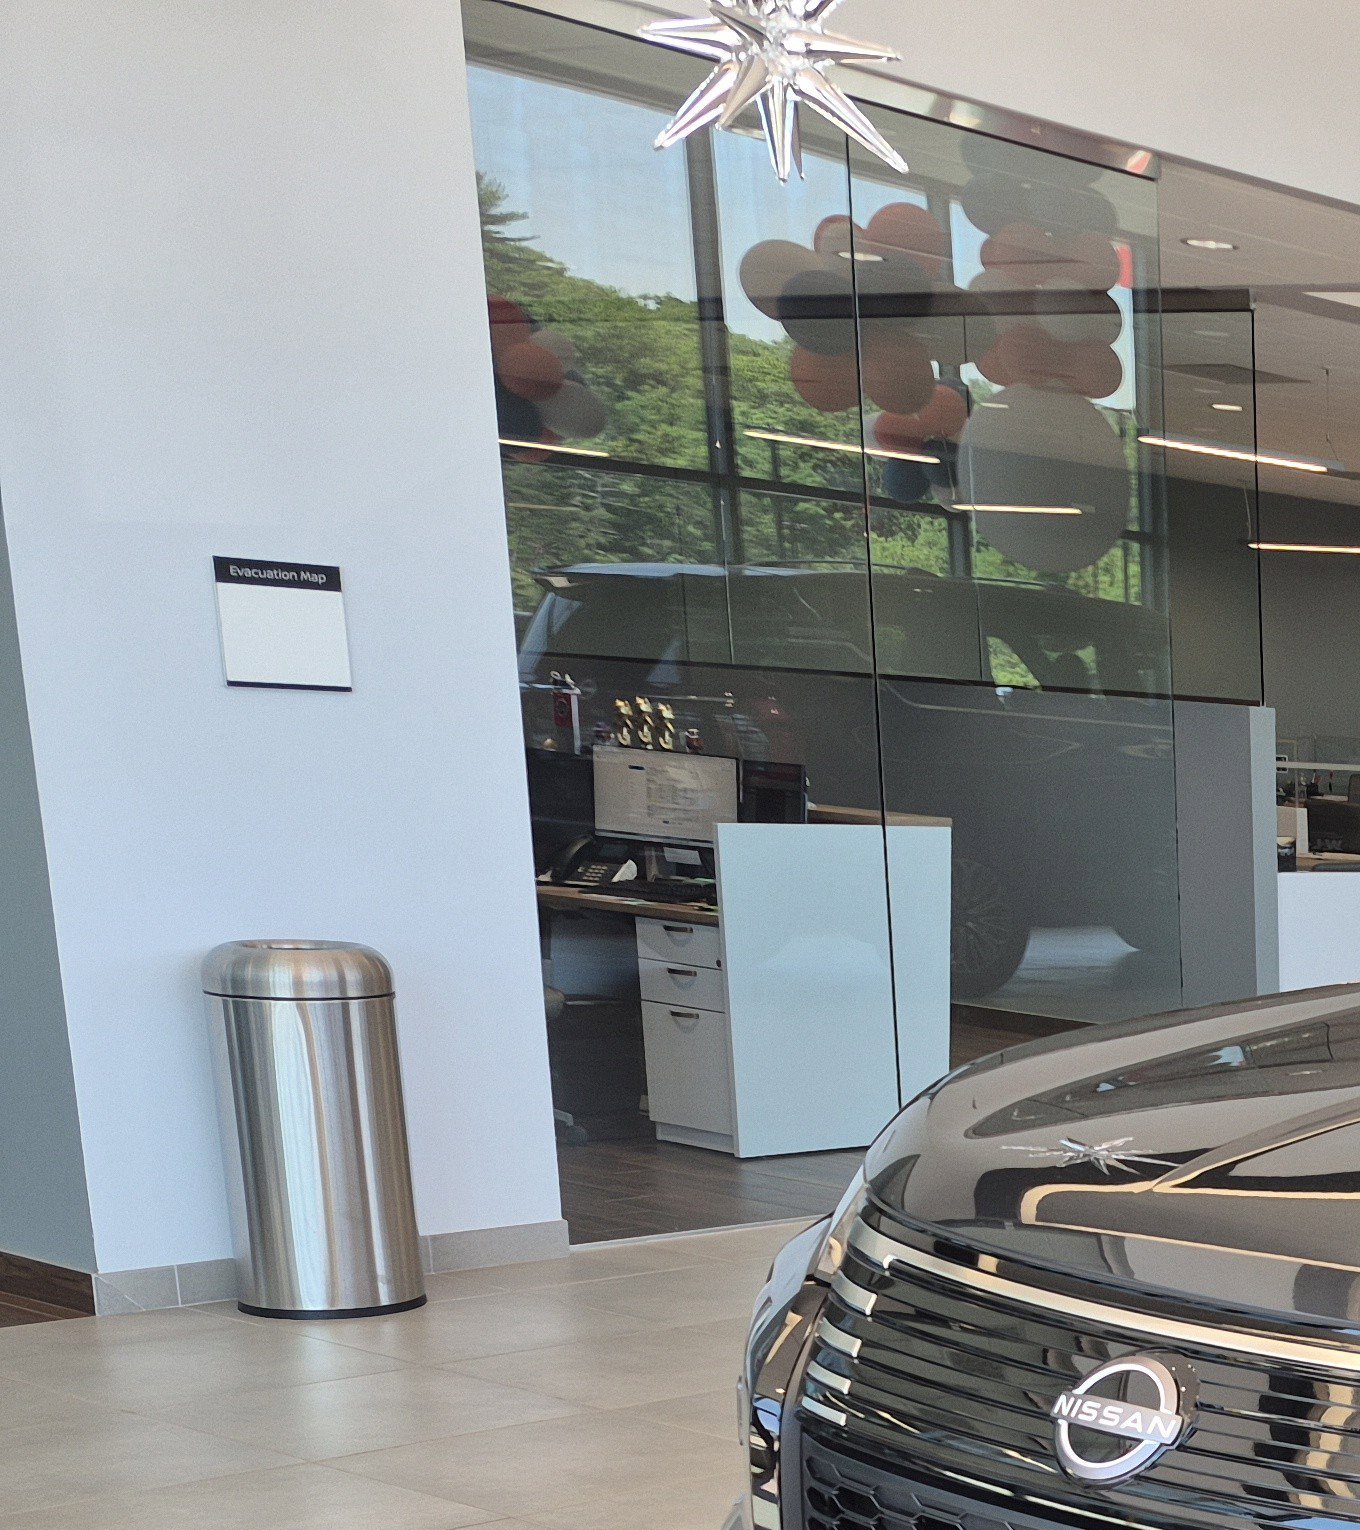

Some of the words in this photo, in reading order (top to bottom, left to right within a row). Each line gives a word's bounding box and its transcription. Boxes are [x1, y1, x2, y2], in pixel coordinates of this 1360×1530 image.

[229, 564, 297, 581] Evacuation
[300, 569, 327, 585] Map
[1053, 1394, 1177, 1438] NISSAN
